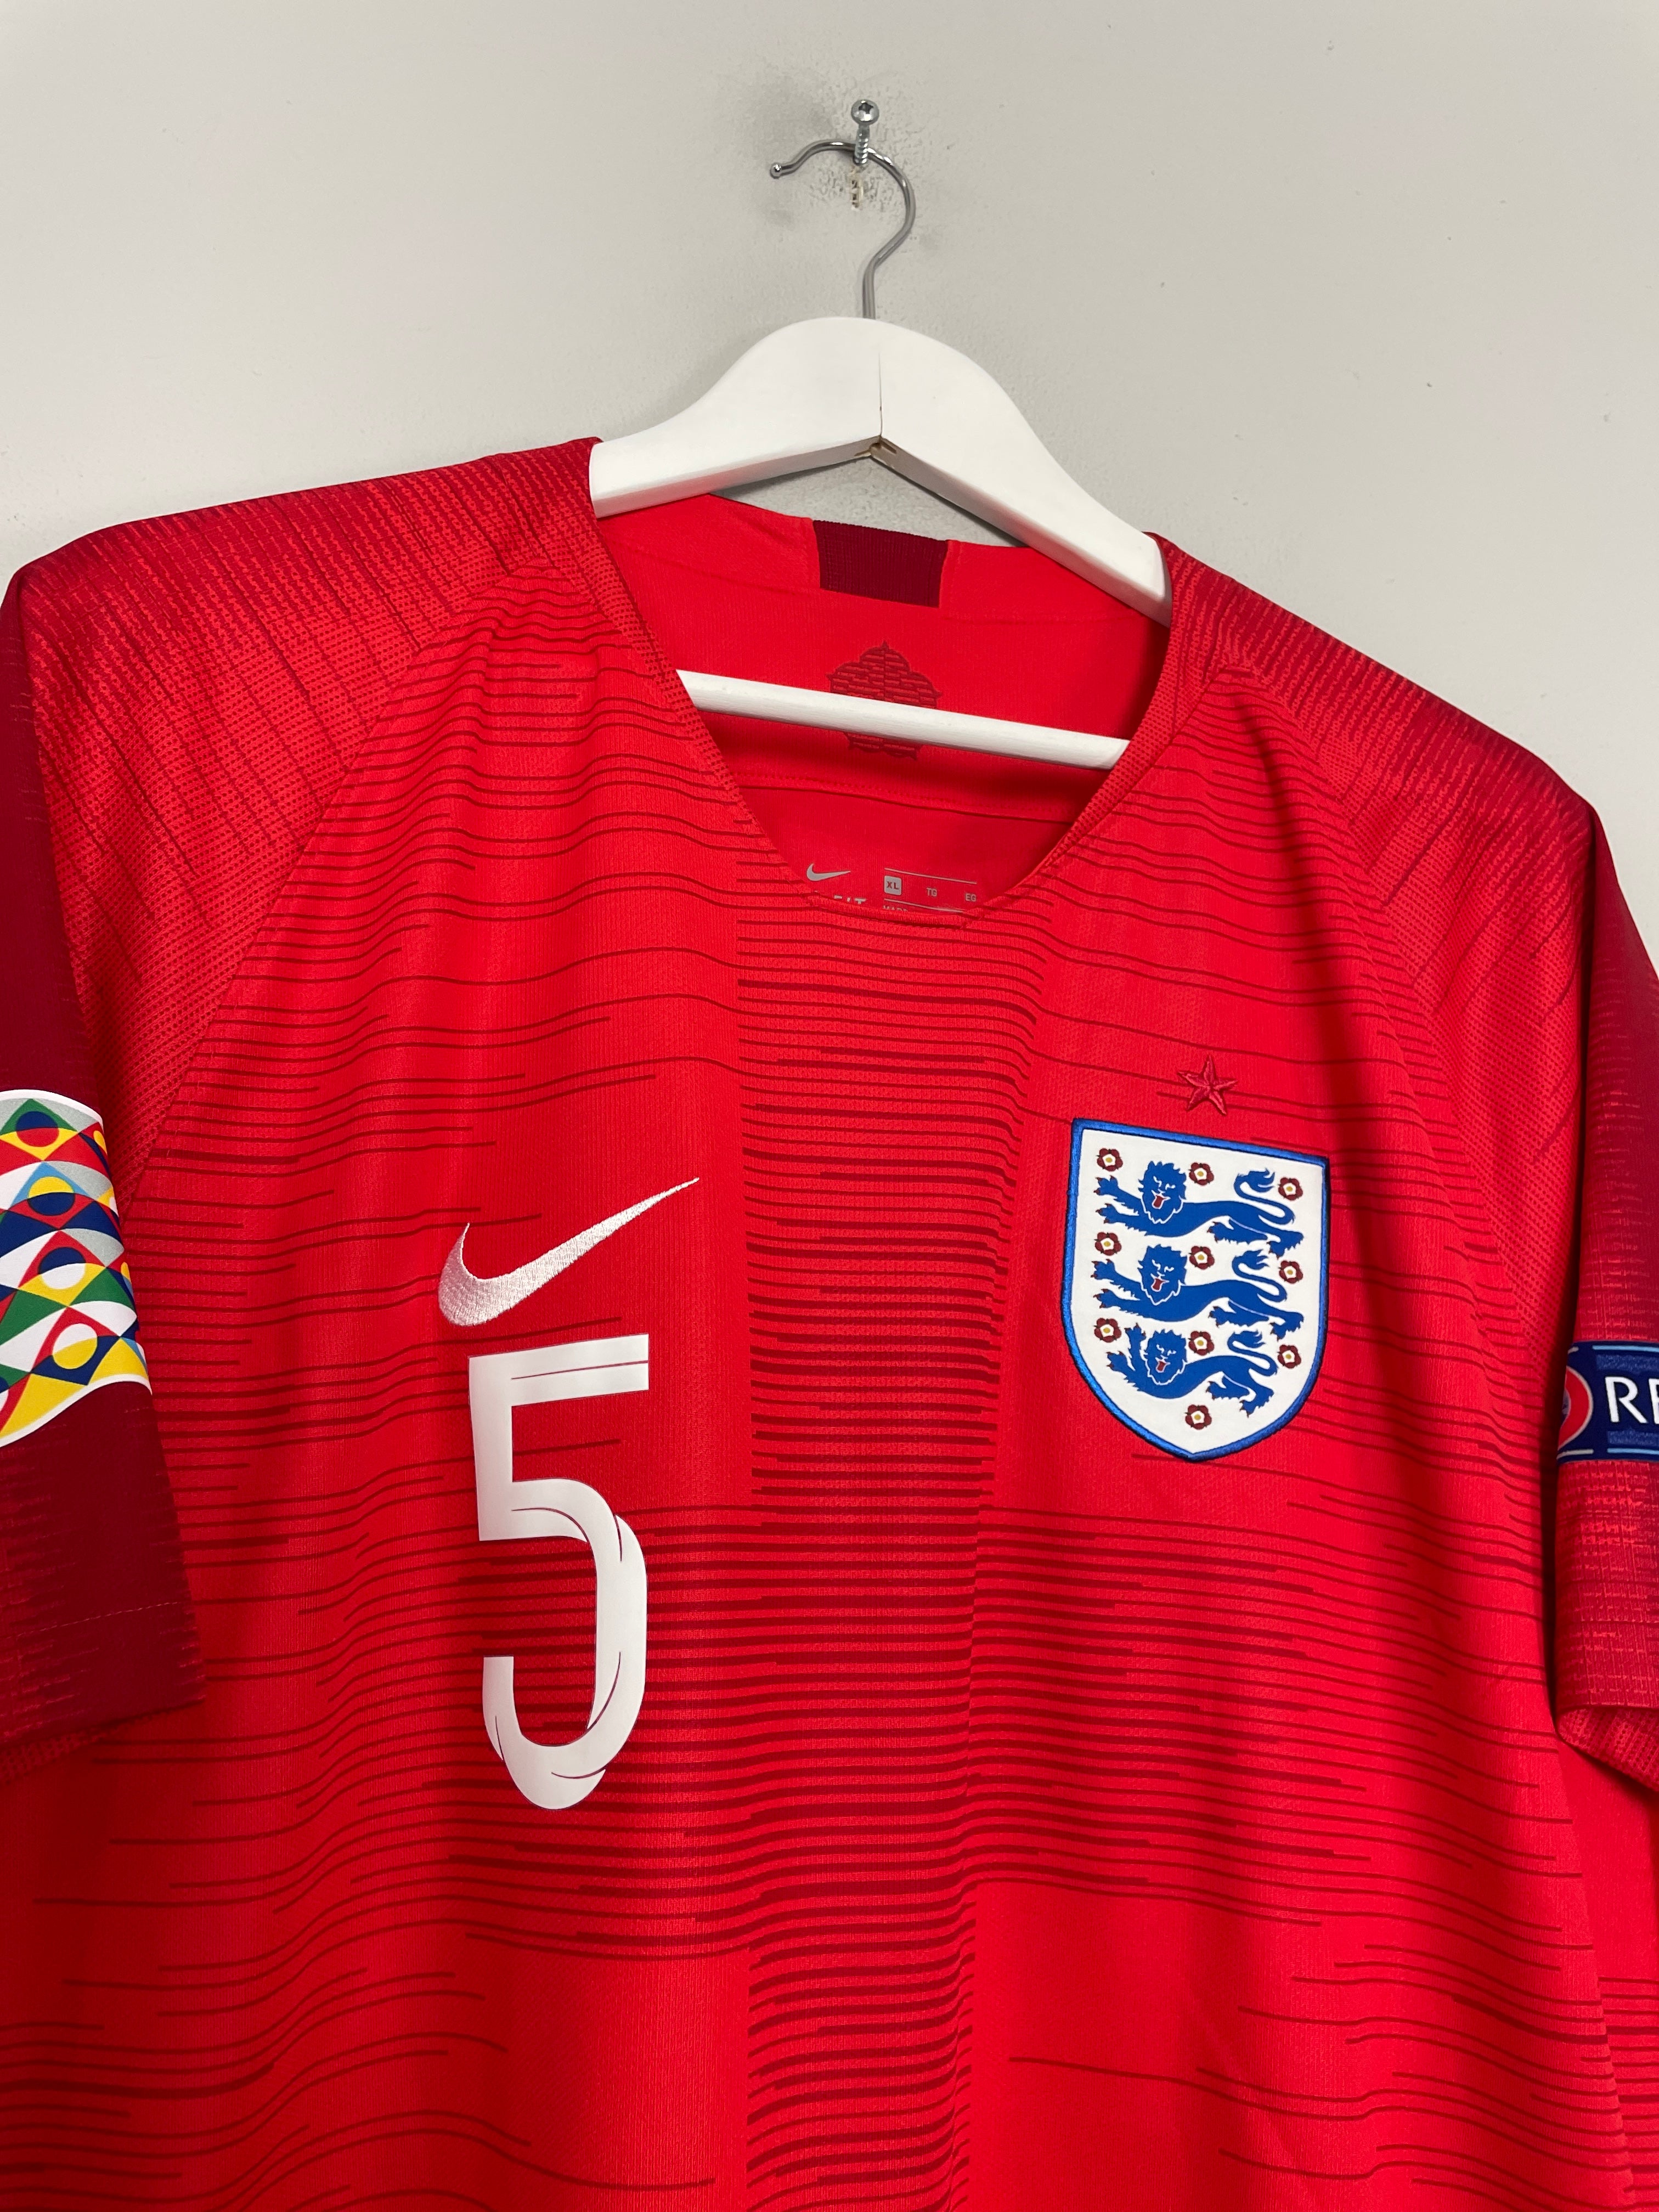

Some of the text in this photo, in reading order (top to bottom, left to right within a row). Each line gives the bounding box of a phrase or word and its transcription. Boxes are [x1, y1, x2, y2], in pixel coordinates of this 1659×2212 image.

[886, 881, 977, 902] XL TG EG
[468, 1333, 650, 1810] 5
